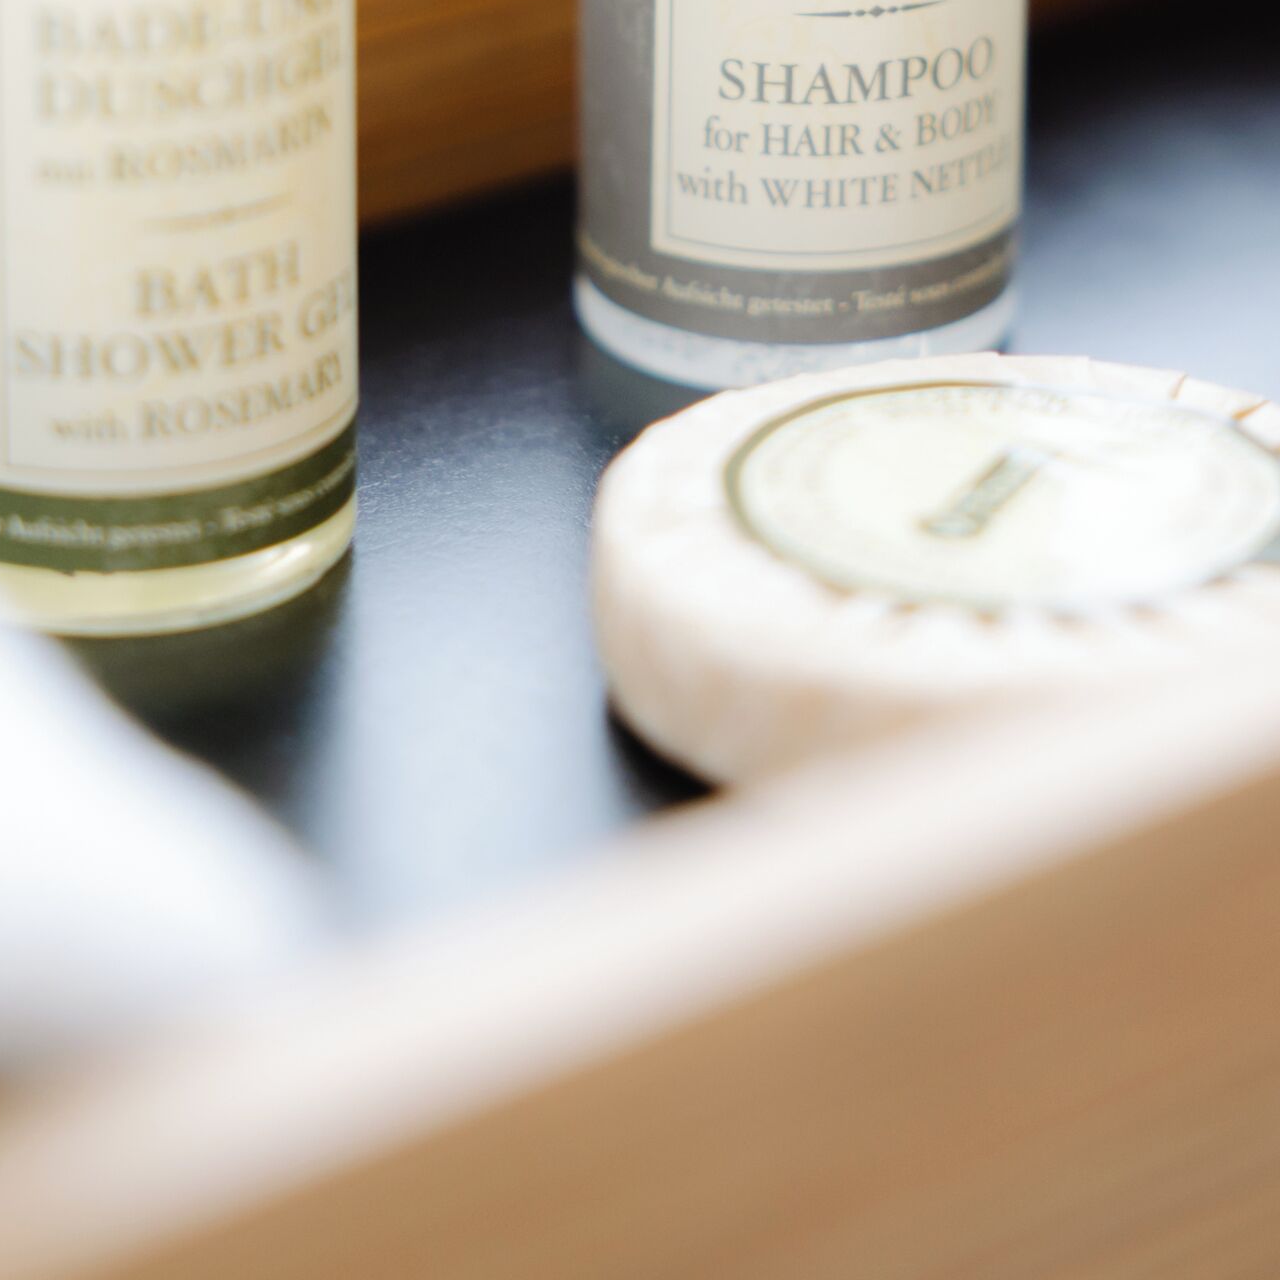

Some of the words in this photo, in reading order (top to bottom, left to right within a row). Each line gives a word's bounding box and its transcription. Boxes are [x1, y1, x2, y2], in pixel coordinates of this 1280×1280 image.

[718, 36, 994, 107] SHAMPOO
[704, 115, 749, 153] for
[761, 122, 863, 157] HAIR
[875, 122, 902, 152] &
[915, 88, 999, 147] BODY
[676, 166, 749, 205] with
[760, 173, 898, 210] WHITE
[910, 141, 1011, 200] NETTLE
[132, 238, 301, 318] BATH
[13, 312, 286, 382] SHOWER
[140, 352, 345, 442] ROSEMARY
